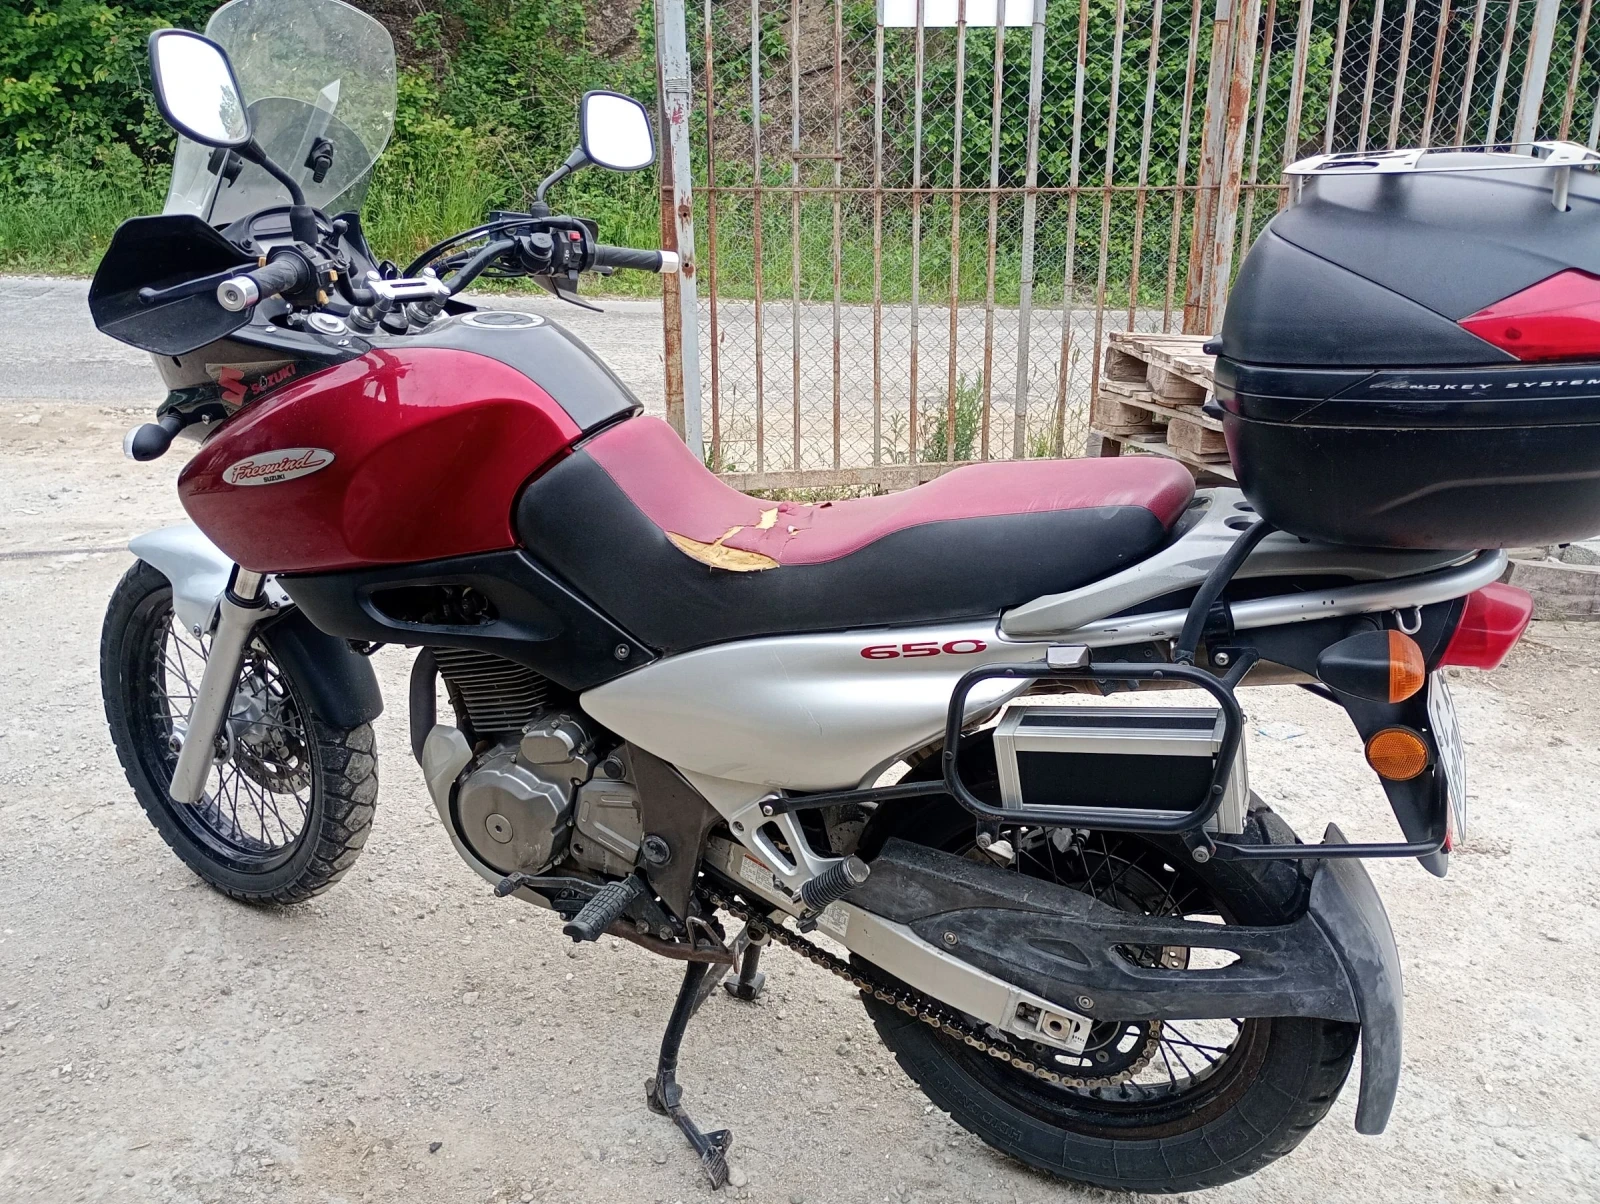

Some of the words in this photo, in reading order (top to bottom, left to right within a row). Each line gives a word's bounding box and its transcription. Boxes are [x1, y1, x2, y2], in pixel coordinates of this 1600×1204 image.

[231, 450, 326, 483] Freewind
[263, 474, 286, 483] SUZUKI
[860, 639, 987, 660] 650
